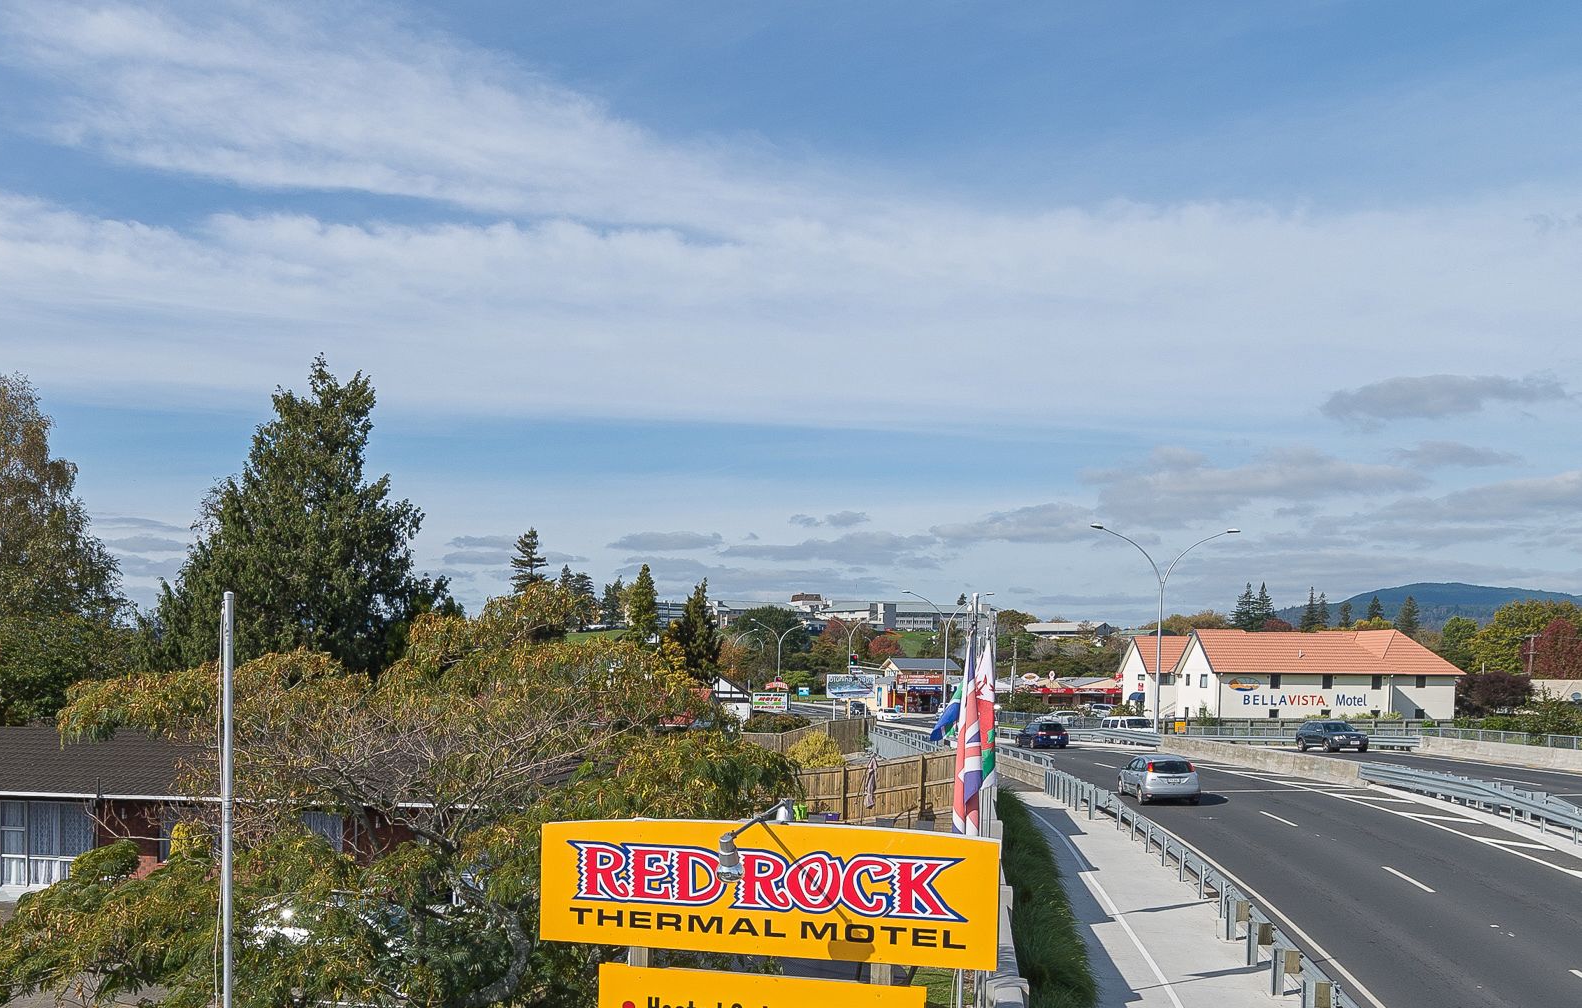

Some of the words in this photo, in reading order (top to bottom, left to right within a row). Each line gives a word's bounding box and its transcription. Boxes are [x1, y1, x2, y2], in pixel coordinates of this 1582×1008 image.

[1335, 693, 1368, 707] Motel
[567, 839, 727, 907] RED
[728, 847, 969, 923] ROCK
[569, 906, 786, 938] THERMAL
[800, 921, 967, 950] MOTEL
